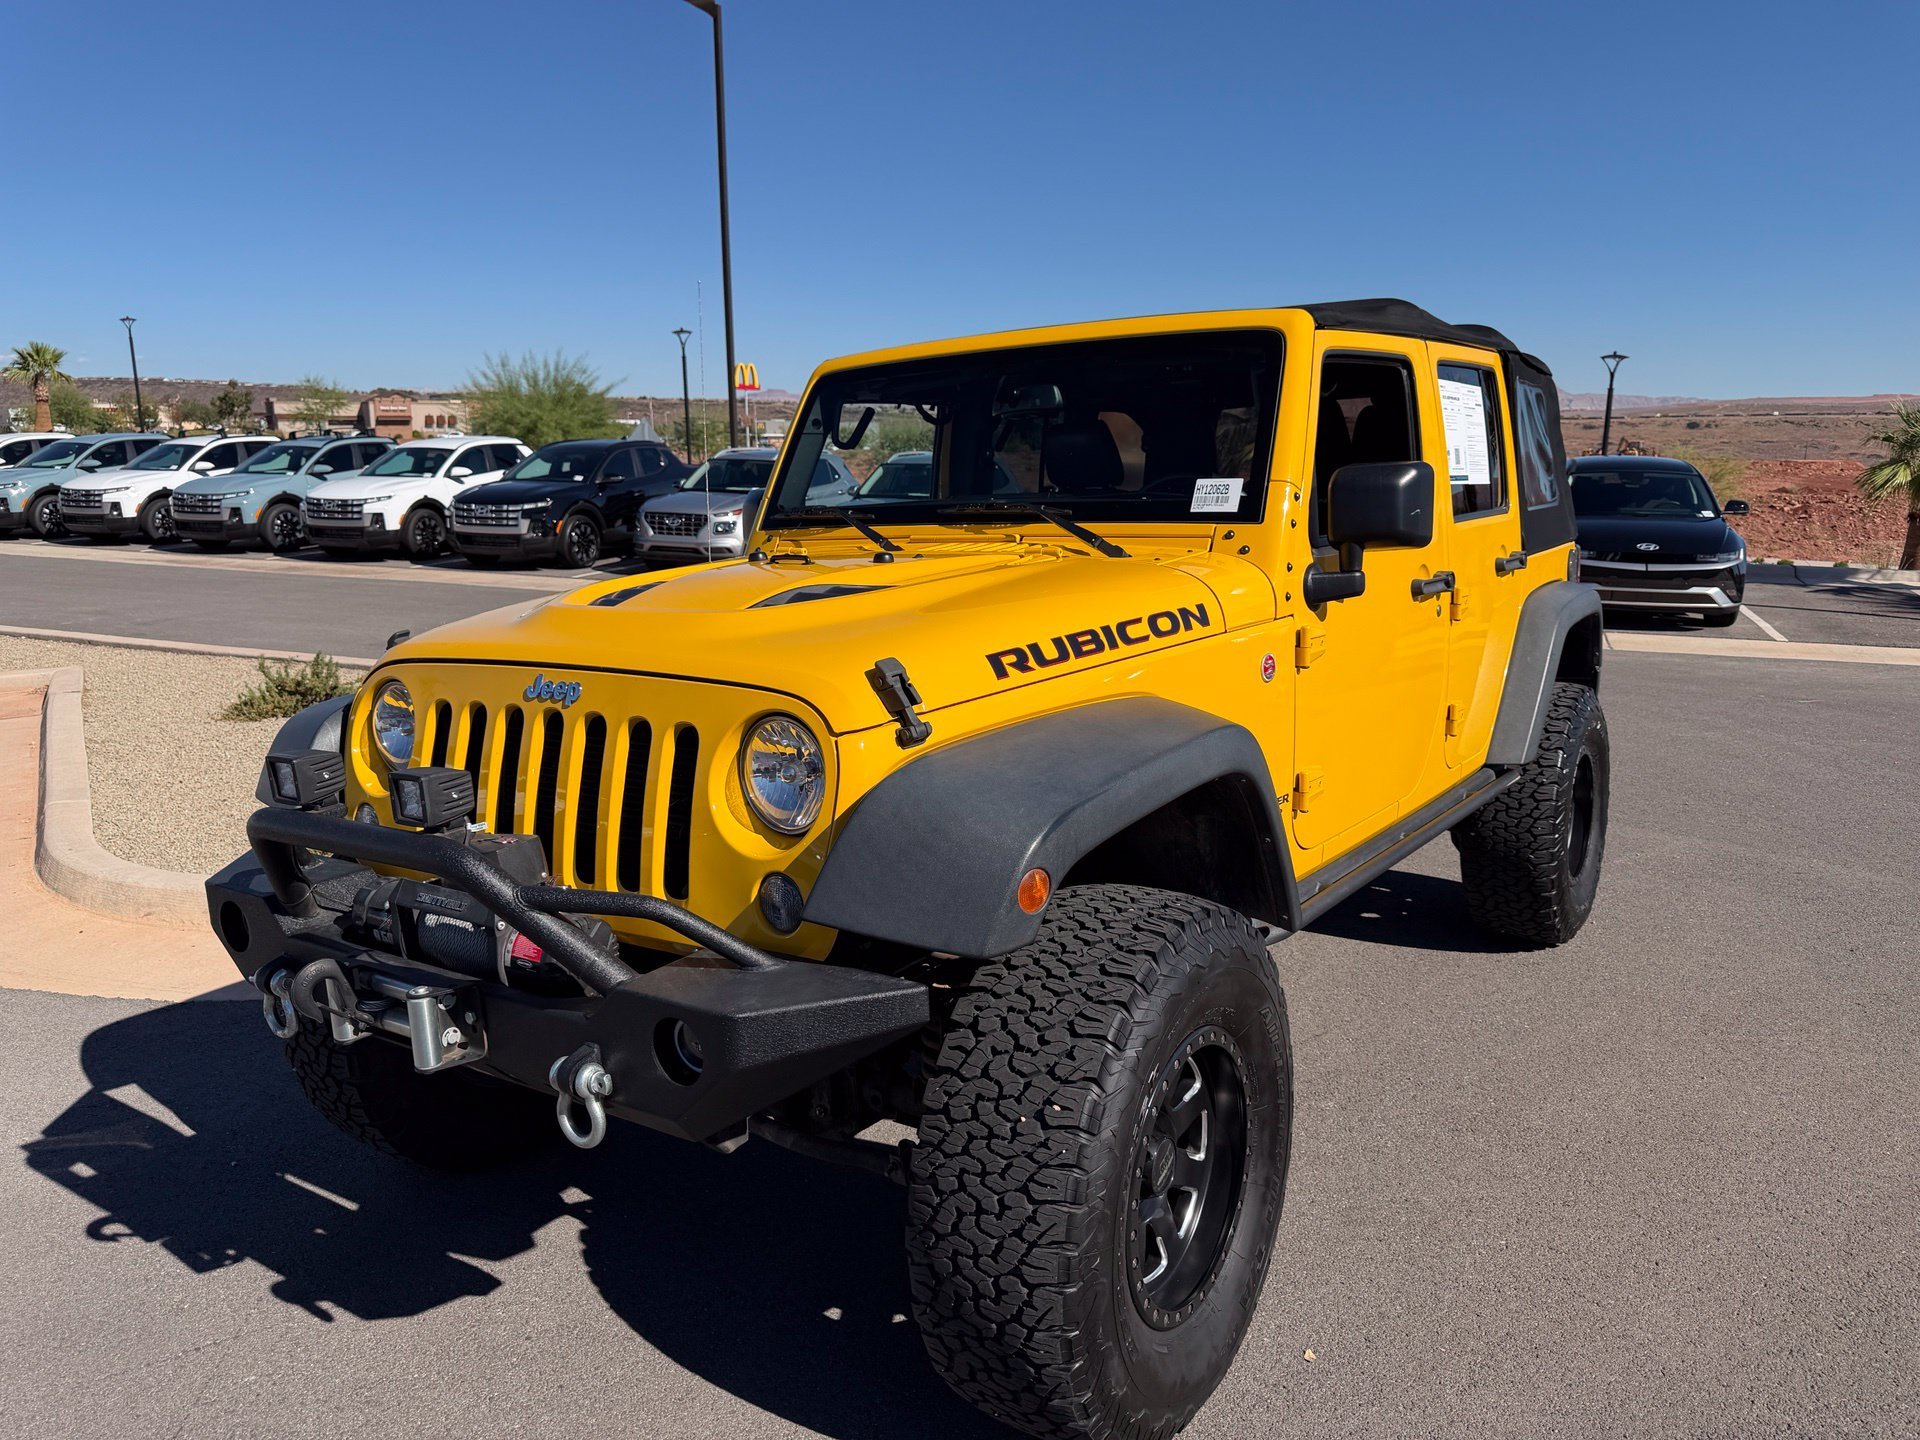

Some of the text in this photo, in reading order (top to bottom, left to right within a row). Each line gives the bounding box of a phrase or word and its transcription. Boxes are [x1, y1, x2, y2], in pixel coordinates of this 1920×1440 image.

[1195, 483, 1231, 495] HY12062B
[985, 603, 1211, 680] RUBICON
[524, 673, 582, 708] Jeep
